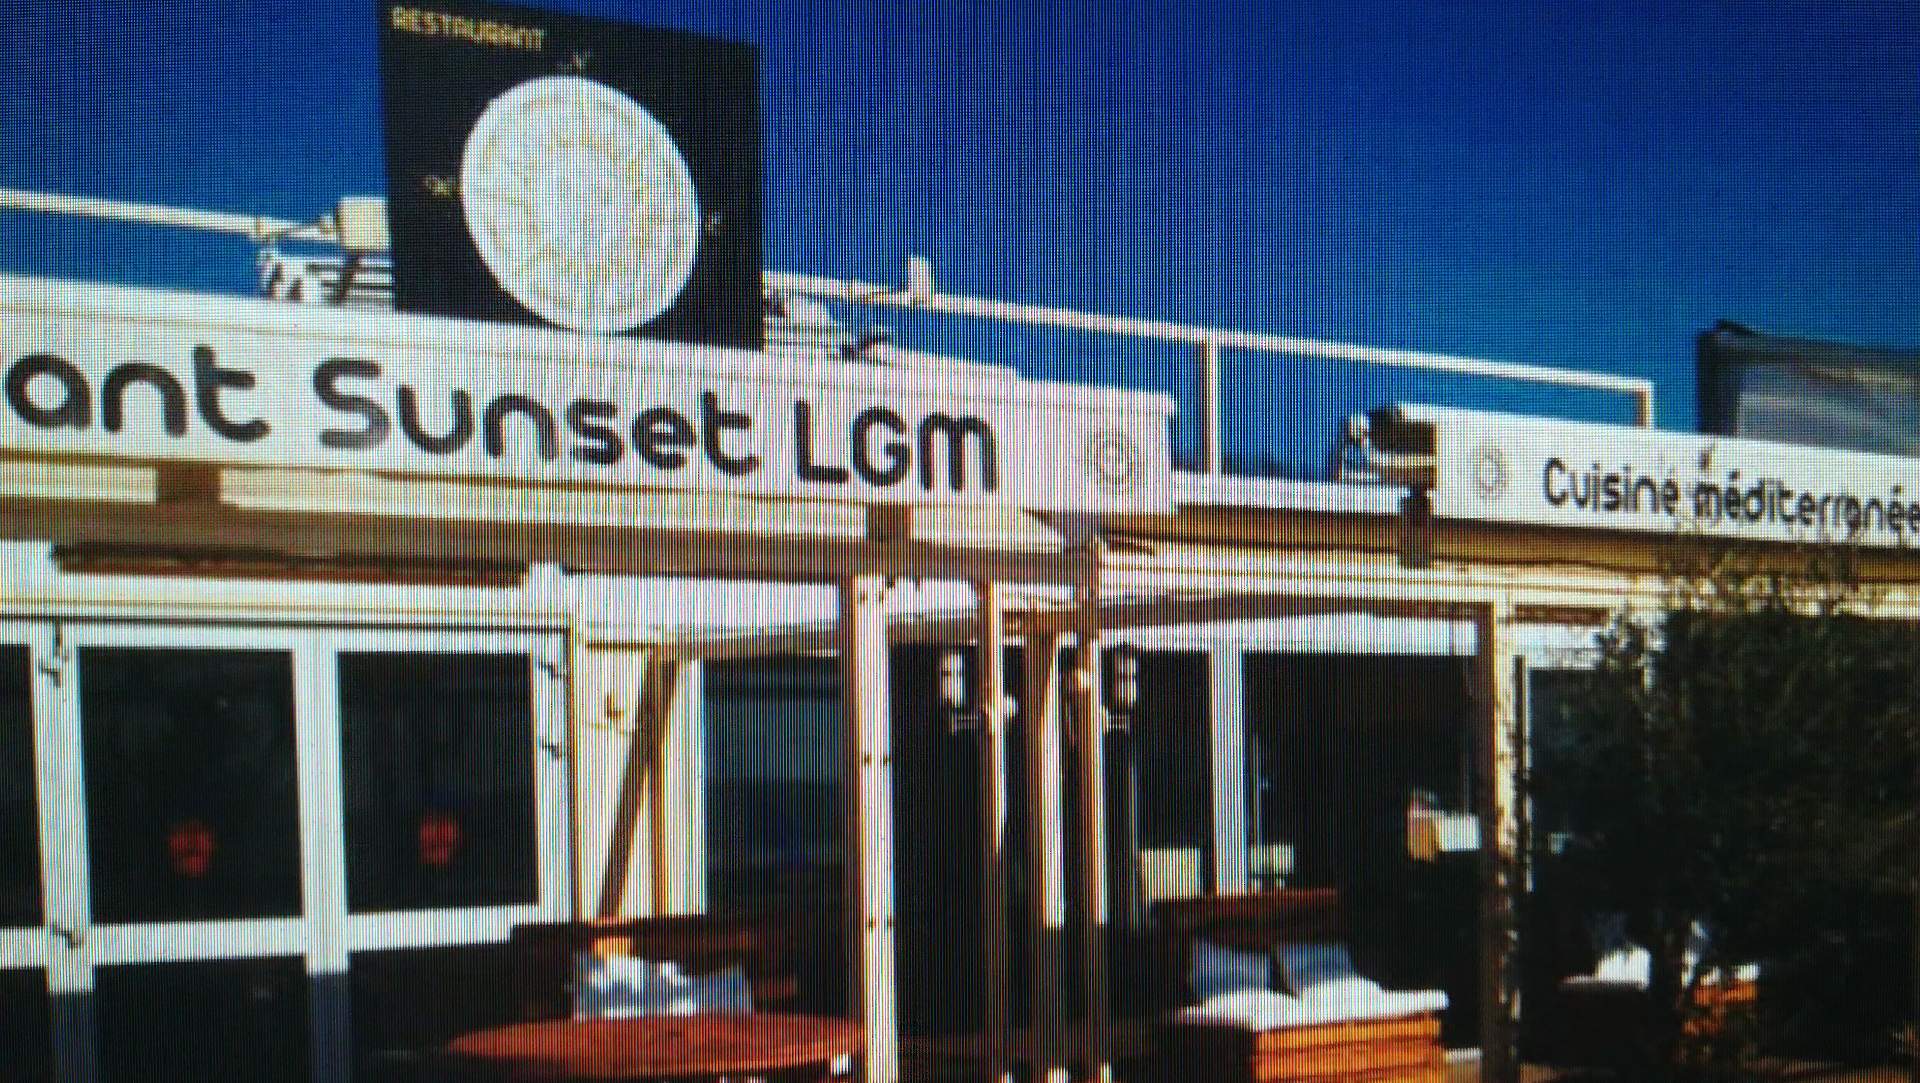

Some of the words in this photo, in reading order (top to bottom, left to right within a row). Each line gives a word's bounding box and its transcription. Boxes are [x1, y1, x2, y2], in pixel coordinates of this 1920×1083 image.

[391, 5, 546, 51] RESTAURANT
[313, 357, 760, 476] Sunset
[793, 399, 998, 493] LGM
[1543, 457, 1680, 517] Cuisine
